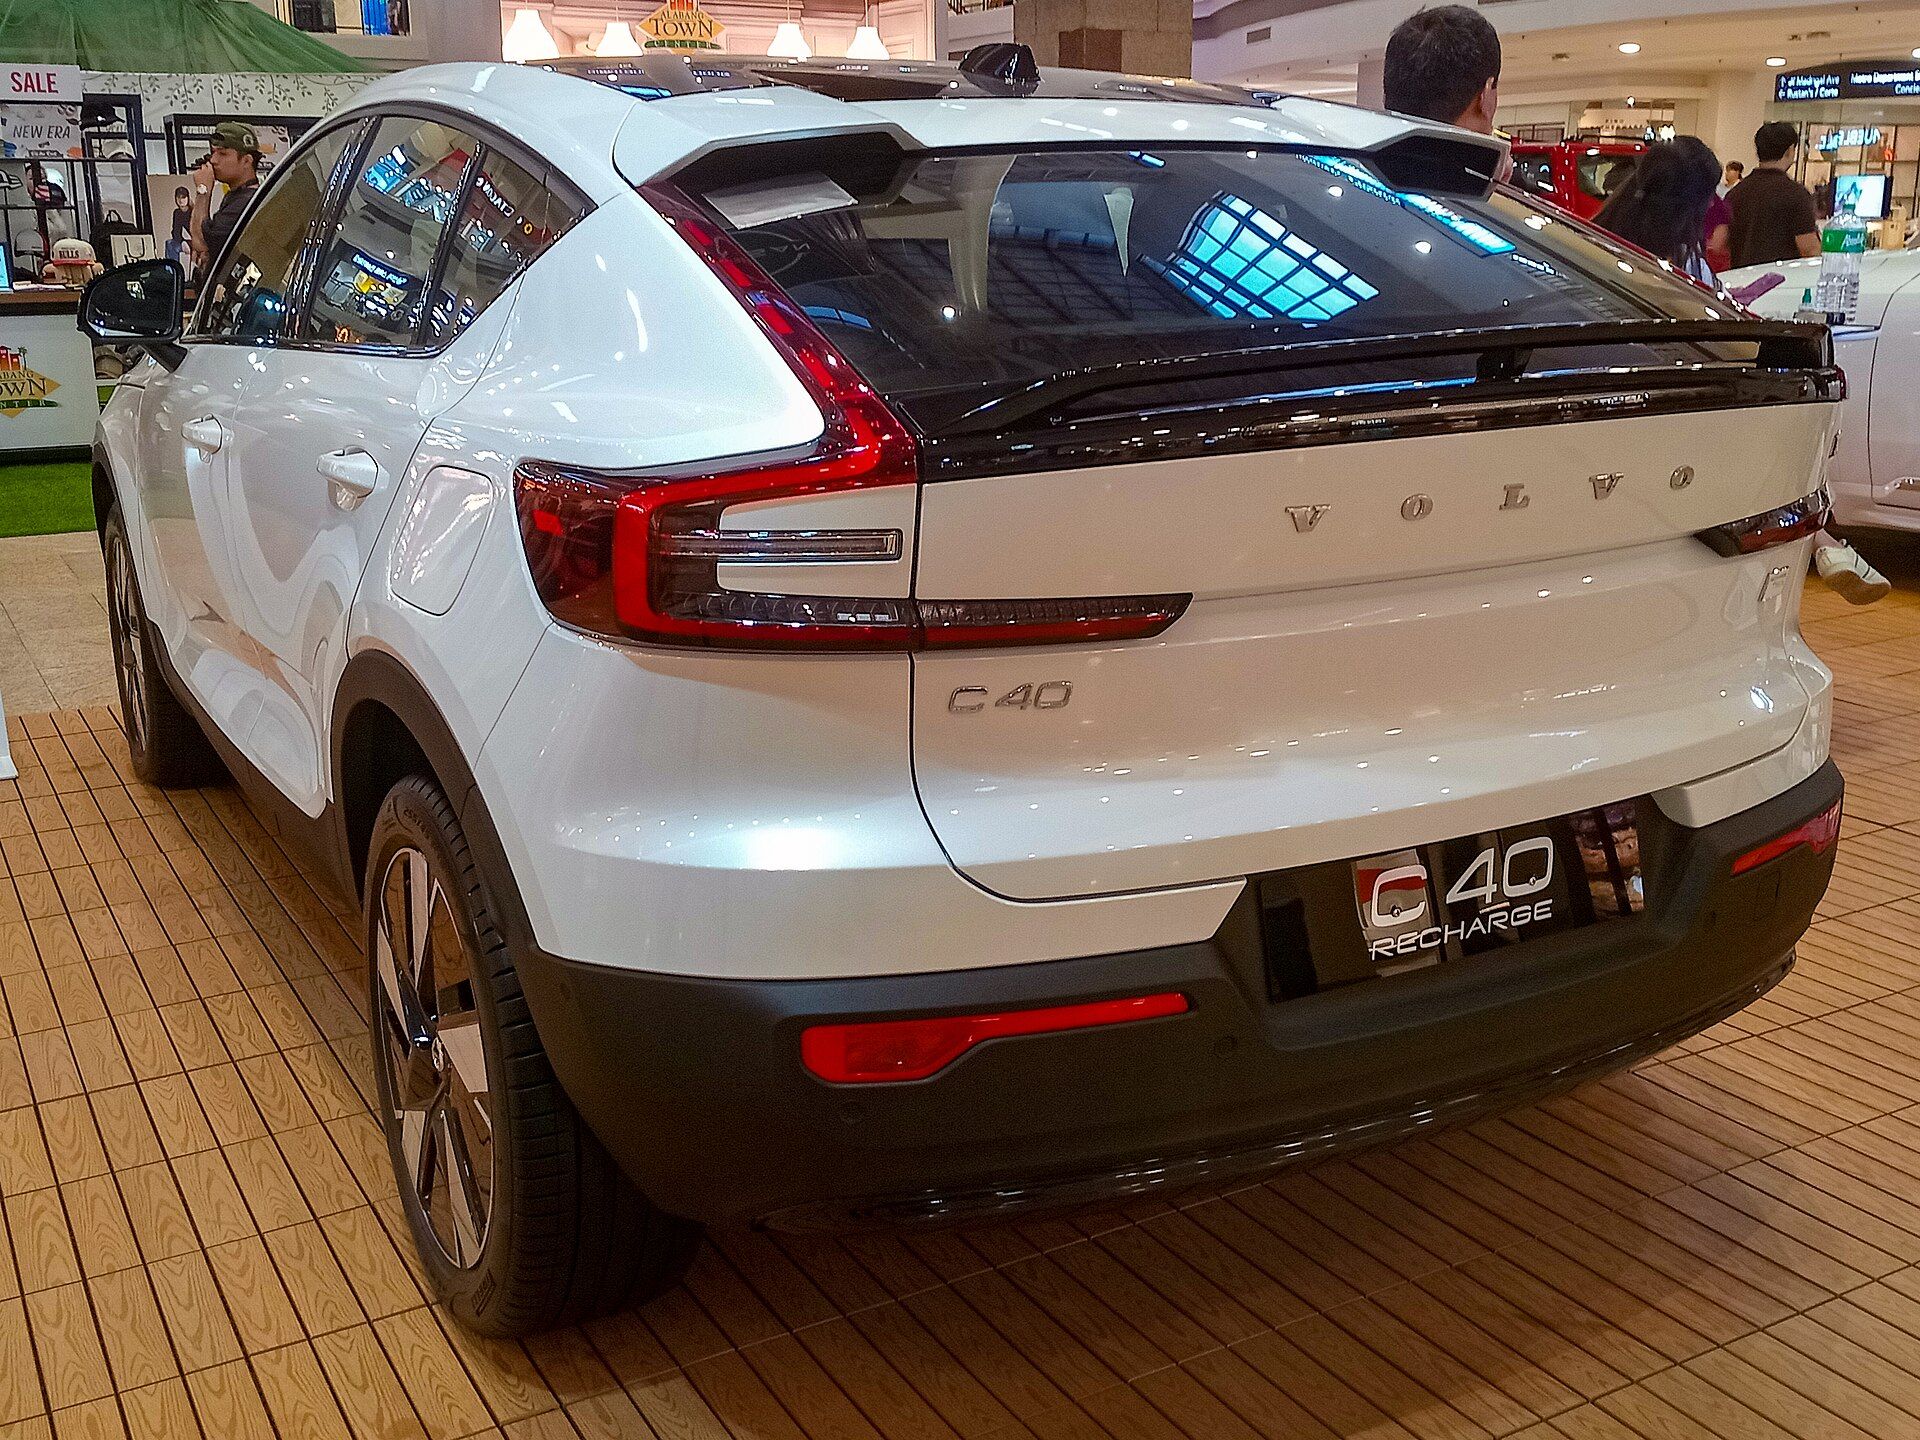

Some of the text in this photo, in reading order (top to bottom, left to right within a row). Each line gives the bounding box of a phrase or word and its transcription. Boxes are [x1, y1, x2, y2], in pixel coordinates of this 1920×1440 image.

[648, 18, 713, 38] TOWN
[10, 71, 59, 94] SALE
[12, 125, 71, 139] NEW ERA
[0, 377, 46, 397] WN
[1285, 464, 1696, 534] VOLVO
[1369, 898, 1554, 961] RECHARGE
